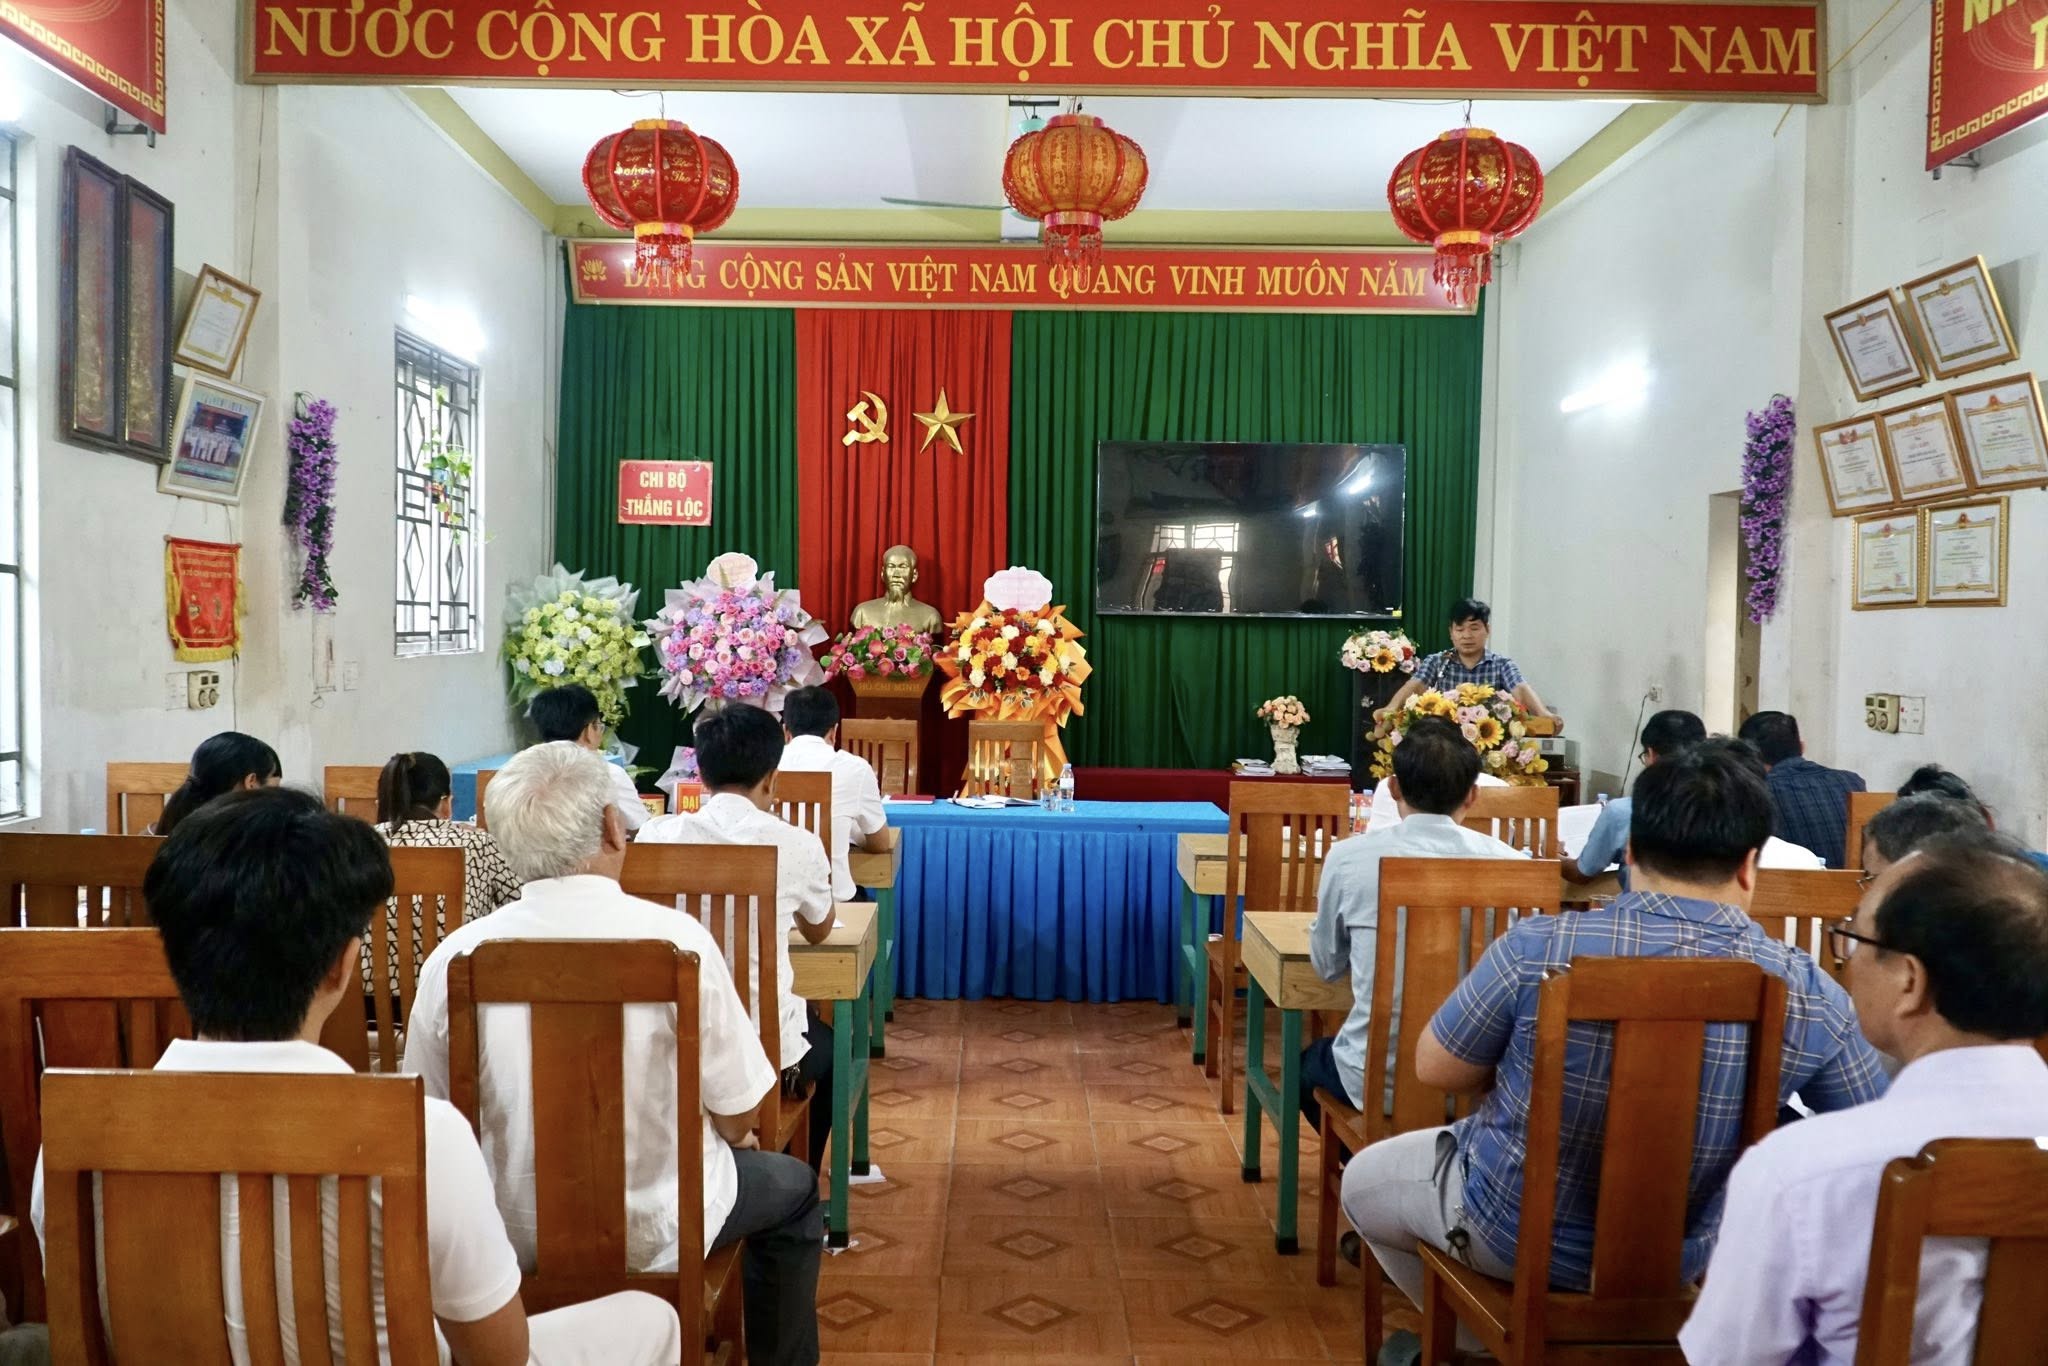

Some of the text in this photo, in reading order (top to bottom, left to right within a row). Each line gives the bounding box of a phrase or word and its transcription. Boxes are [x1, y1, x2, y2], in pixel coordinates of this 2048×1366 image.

[477, 0, 666, 76] CỘNG
[686, 0, 830, 65] HÒA
[845, 2, 935, 66] XÃ
[949, 3, 1073, 81] HỘI
[1093, 6, 1232, 69] CHỦ
[1253, 9, 1473, 71] NGHĨA
[1491, 10, 1649, 87] VIỆT
[1669, 26, 1816, 76] NAM
[719, 252, 805, 298] CỘNG
[815, 253, 874, 292] SẢN
[886, 255, 958, 299] VIỆT
[969, 263, 1037, 293] NAM
[1048, 264, 1156, 299] QUANG
[1168, 265, 1247, 295] VINH
[1255, 258, 1349, 297] MUÔN
[1358, 260, 1427, 297] NĂM
[640, 468, 687, 493] CHI BỘ
[626, 493, 704, 521] THẮNG LỘC
